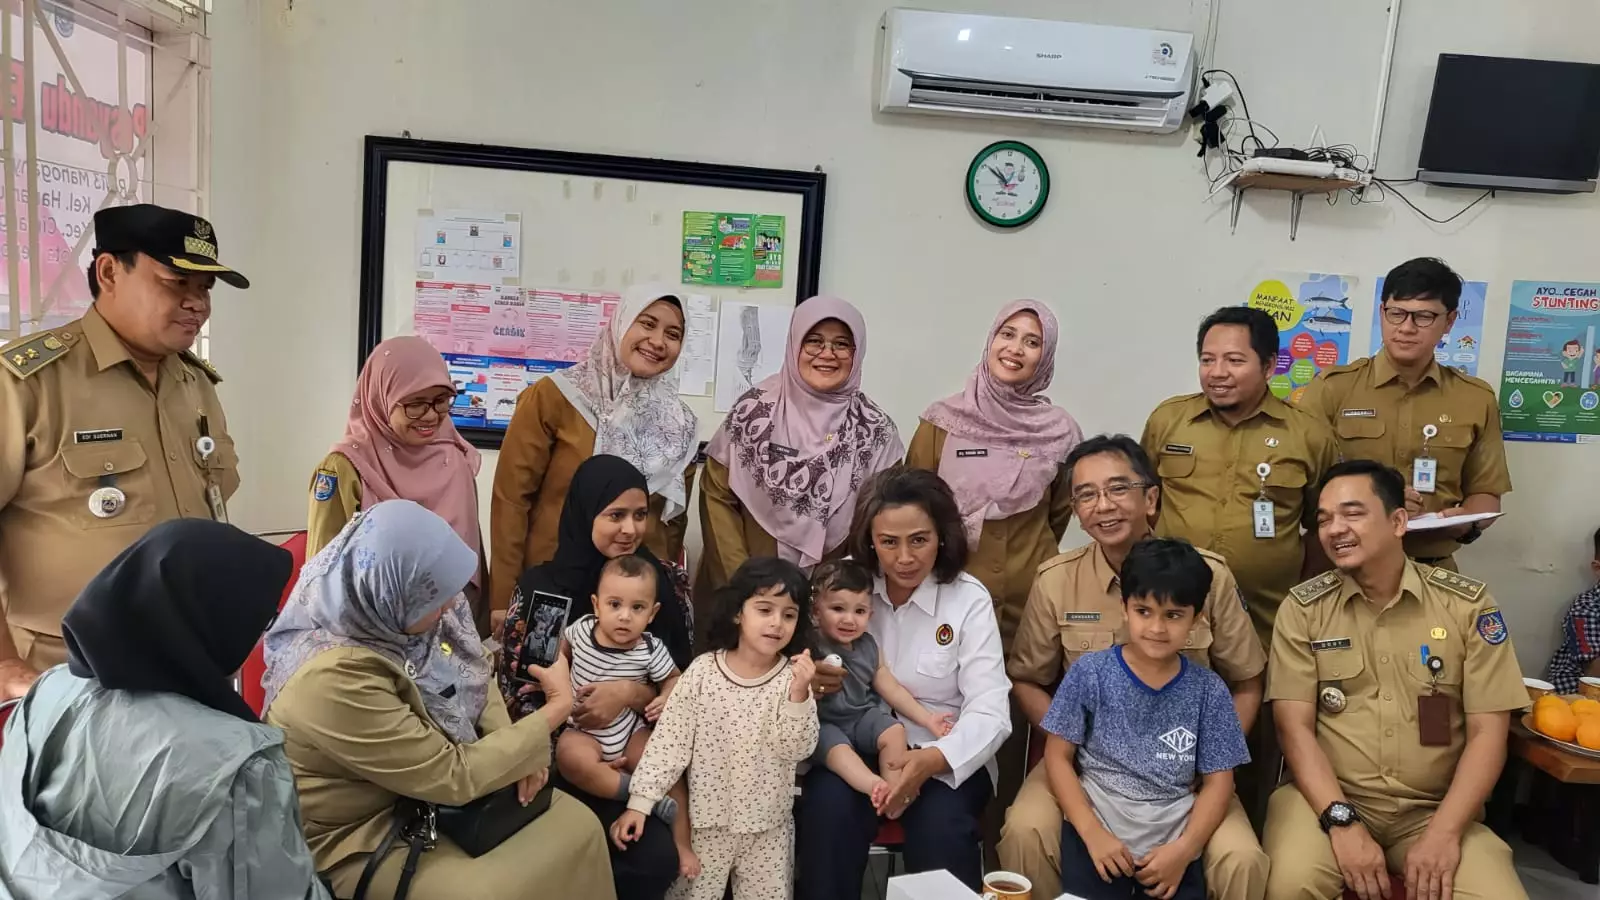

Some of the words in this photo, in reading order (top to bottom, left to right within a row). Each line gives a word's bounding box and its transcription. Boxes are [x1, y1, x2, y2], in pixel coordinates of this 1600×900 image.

[1256, 293, 1295, 305] MANFAAT
[1532, 296, 1599, 310] STUNTING
[1505, 370, 1544, 378] BAGAIMANA
[1167, 731, 1193, 750] NYC
[1156, 752, 1176, 760] NEW
